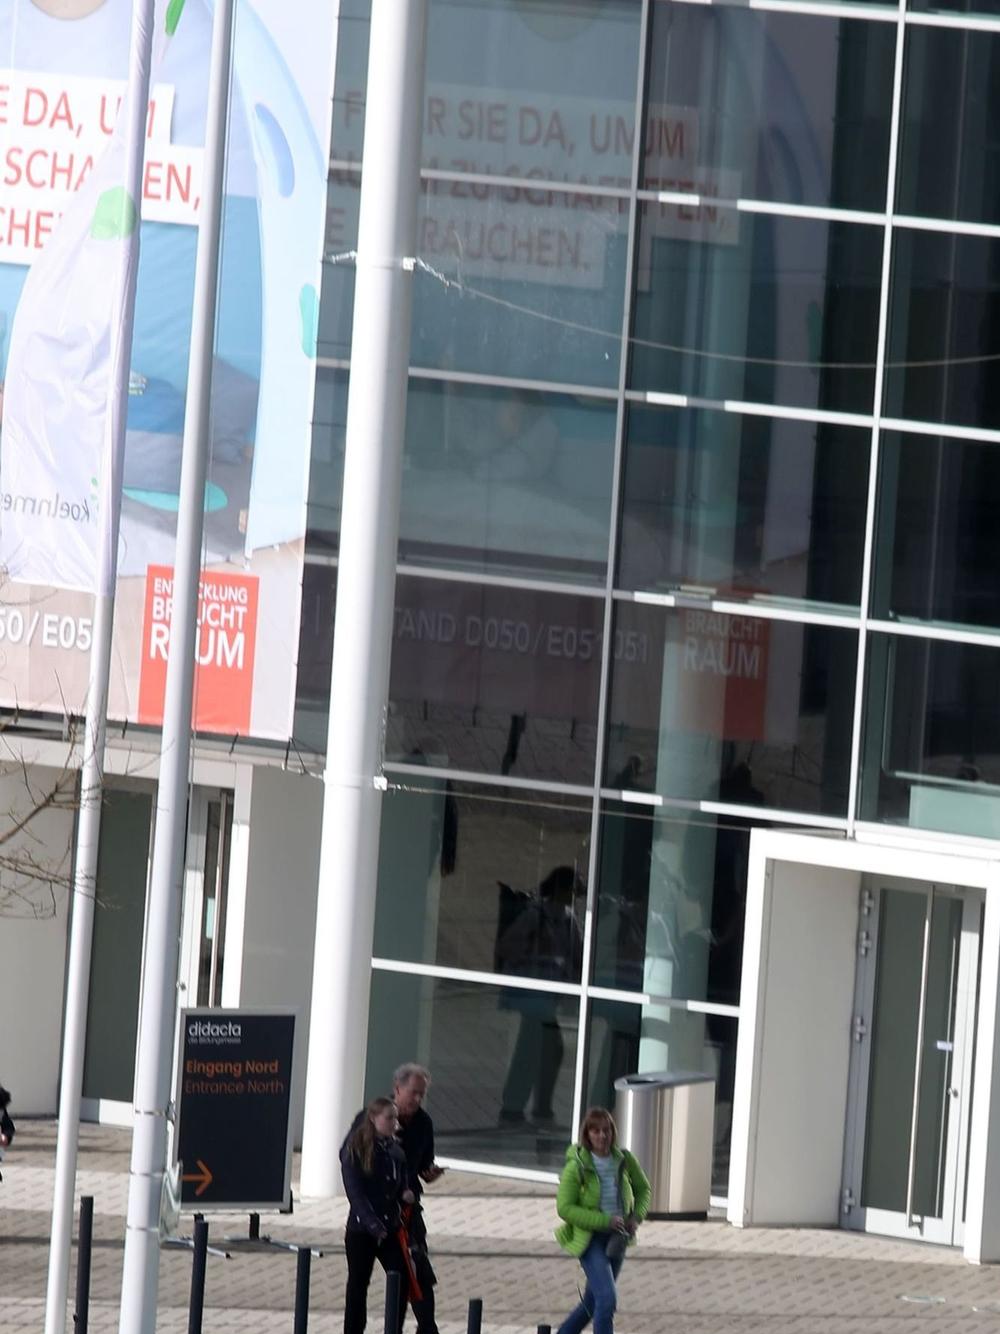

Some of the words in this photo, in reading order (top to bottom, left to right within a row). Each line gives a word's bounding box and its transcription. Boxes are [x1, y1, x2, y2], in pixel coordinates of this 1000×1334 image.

[23, 87, 83, 138] DA,
[149, 621, 246, 671] RUM
[683, 636, 761, 680] RAUM
[188, 1020, 242, 1037] didacta
[186, 1059, 242, 1078] Eingang
[245, 1061, 279, 1073] Nord
[185, 1079, 245, 1095] Entrance
[247, 1080, 284, 1095] North
